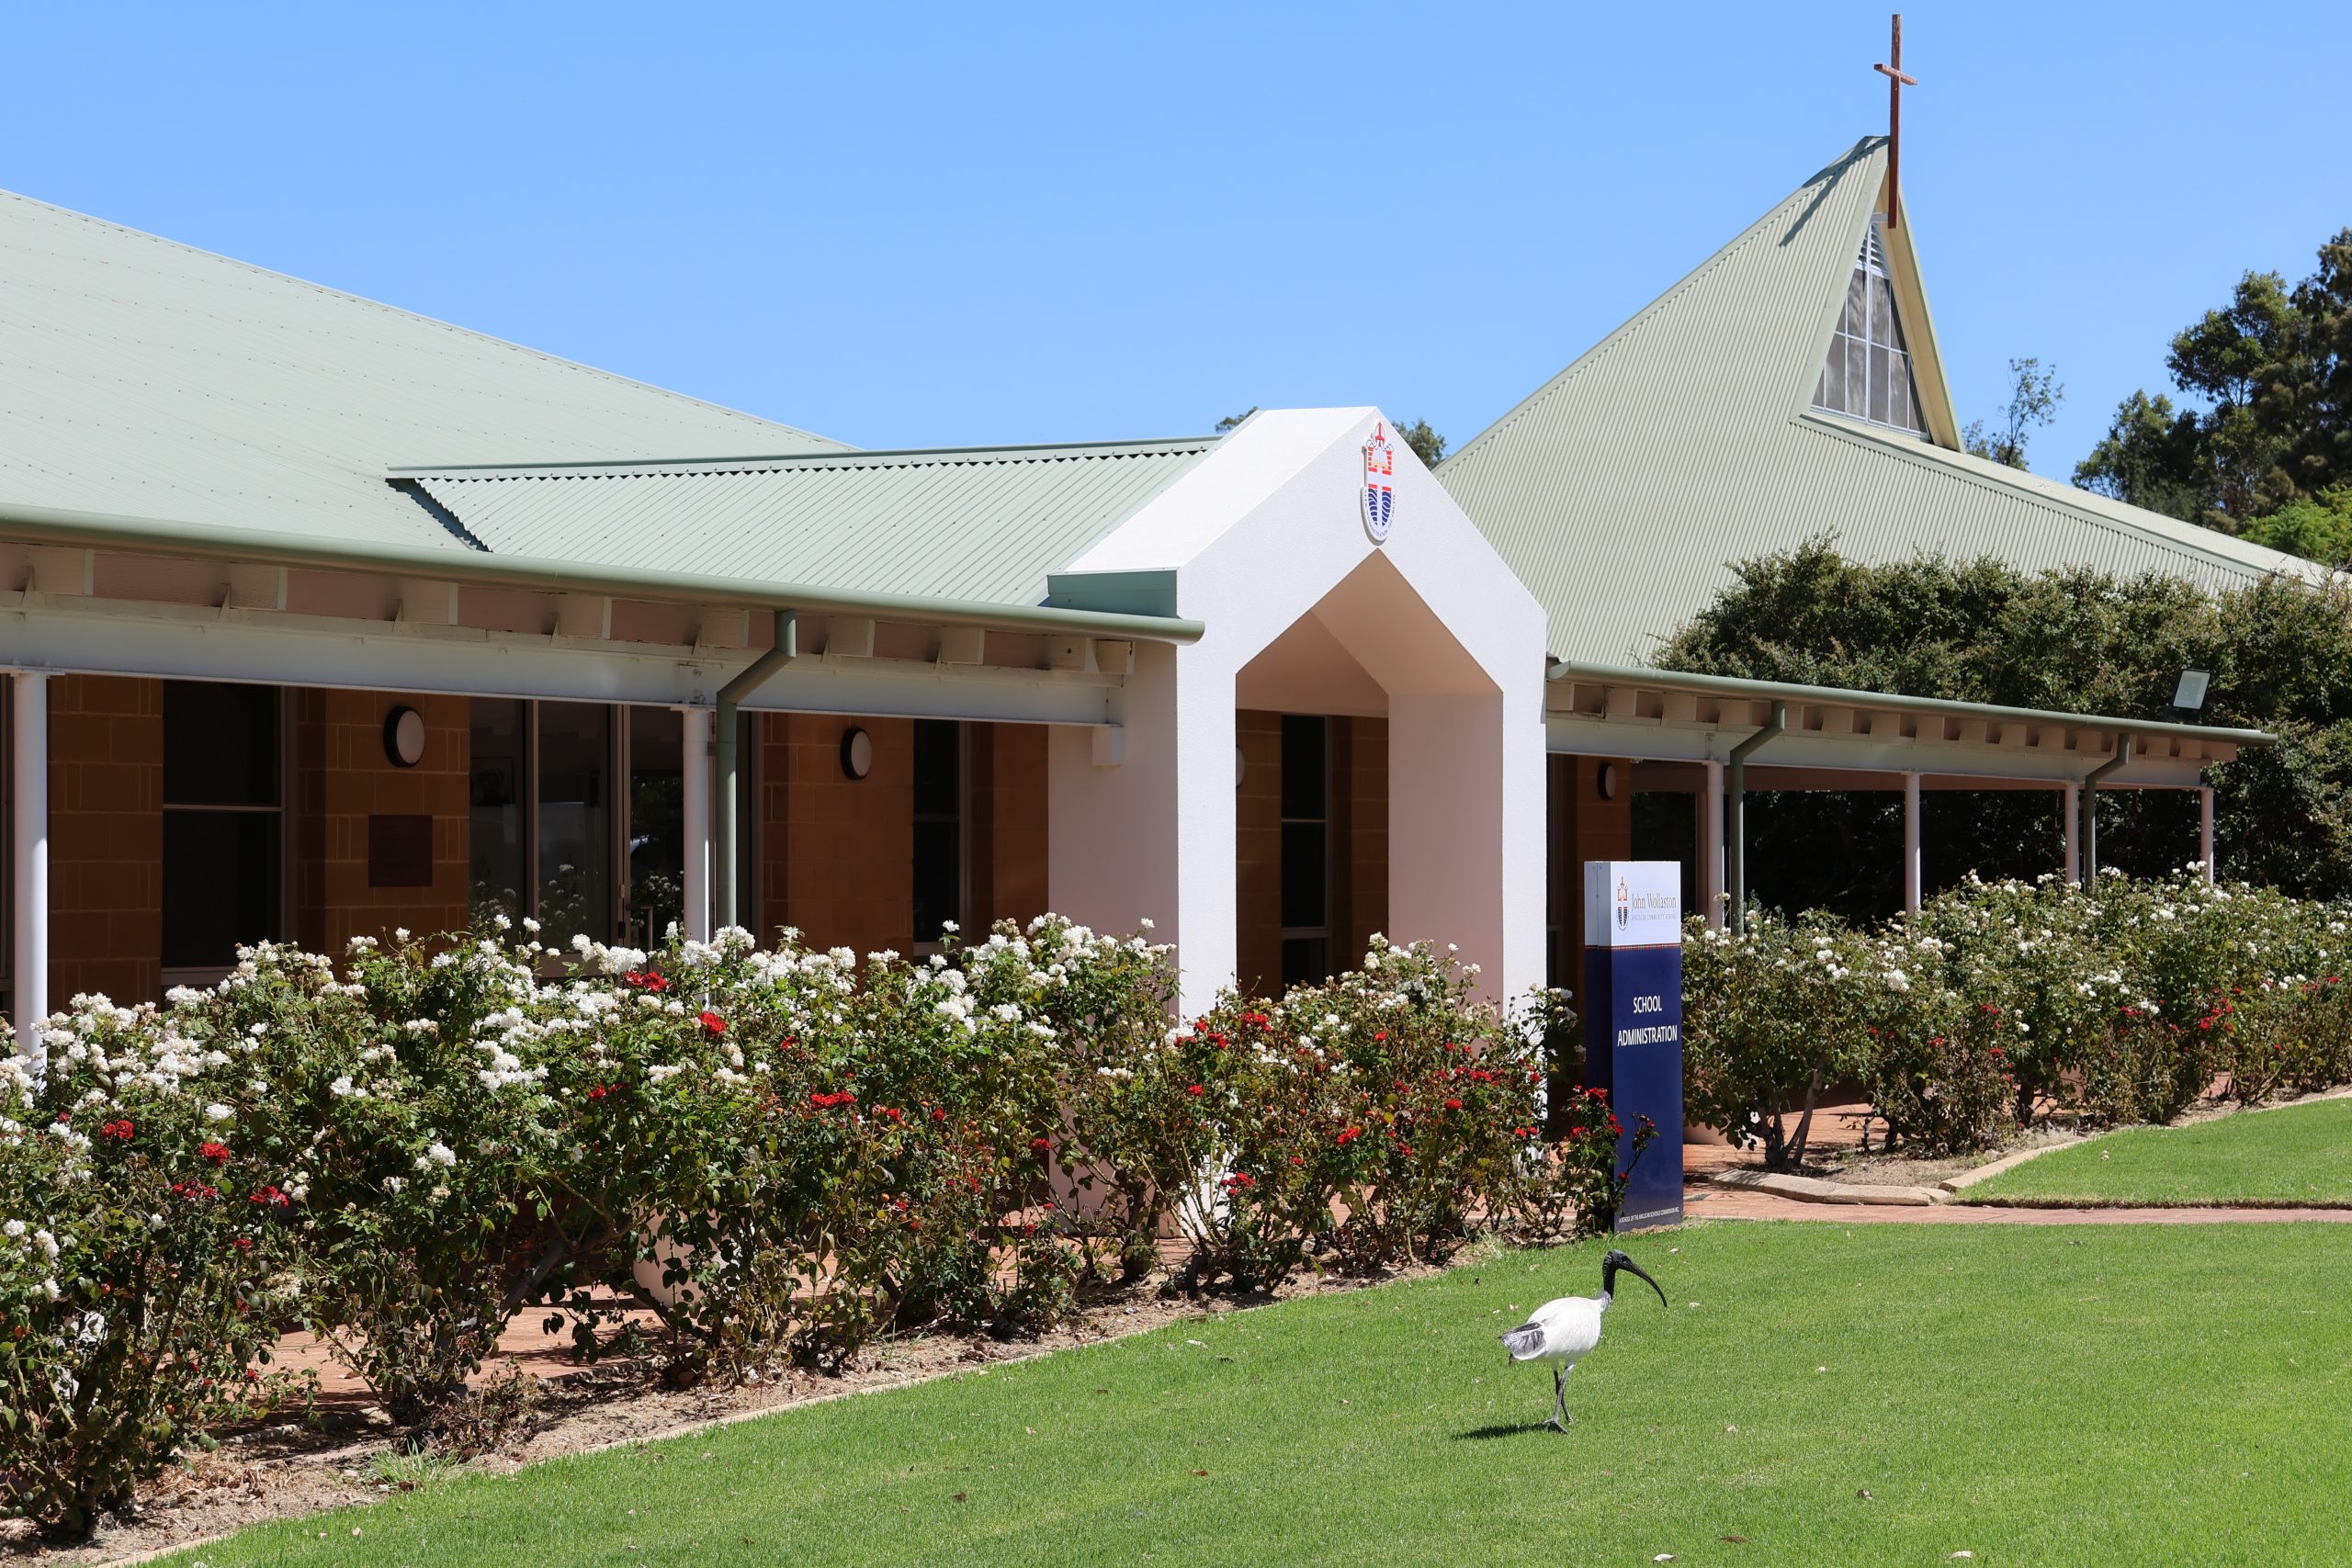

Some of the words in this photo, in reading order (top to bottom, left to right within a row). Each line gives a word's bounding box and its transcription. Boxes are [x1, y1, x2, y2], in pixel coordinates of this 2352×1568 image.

[1631, 893, 1646, 911] John
[1646, 892, 1677, 908] Wollaston
[1633, 995, 1662, 1014] SCHOOL
[1617, 1024, 1678, 1047] ADMINISTRATION
